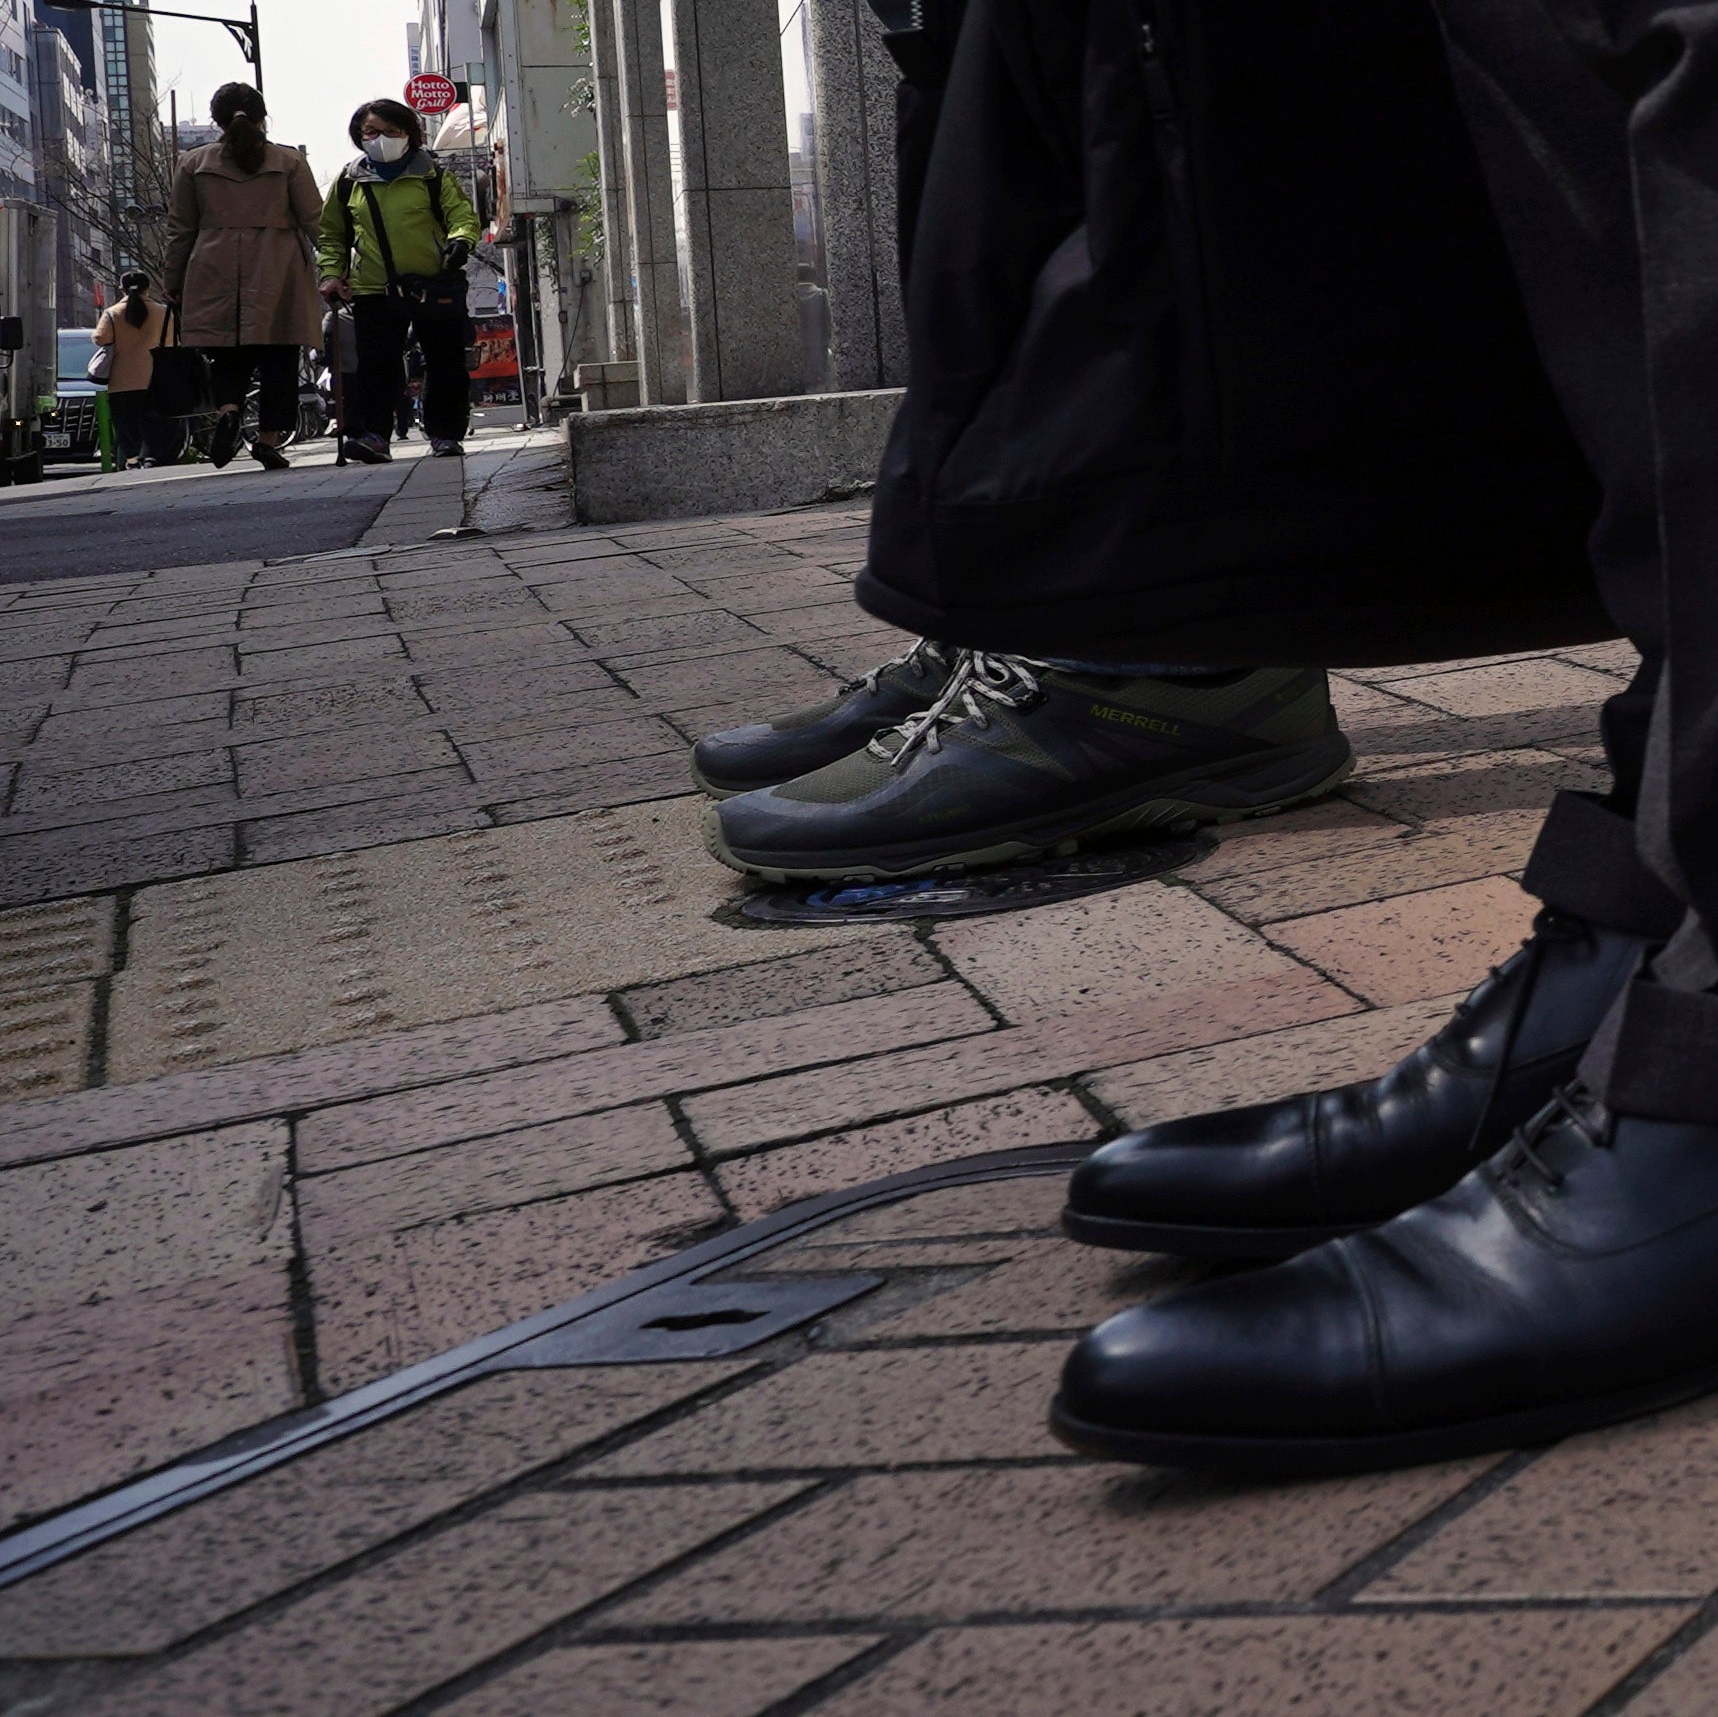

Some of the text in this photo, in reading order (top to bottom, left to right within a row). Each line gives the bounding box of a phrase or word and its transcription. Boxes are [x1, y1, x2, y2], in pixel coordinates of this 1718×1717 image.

[411, 80, 449, 89] Hotto
[411, 89, 451, 99] Motto
[416, 98, 446, 110] Grill
